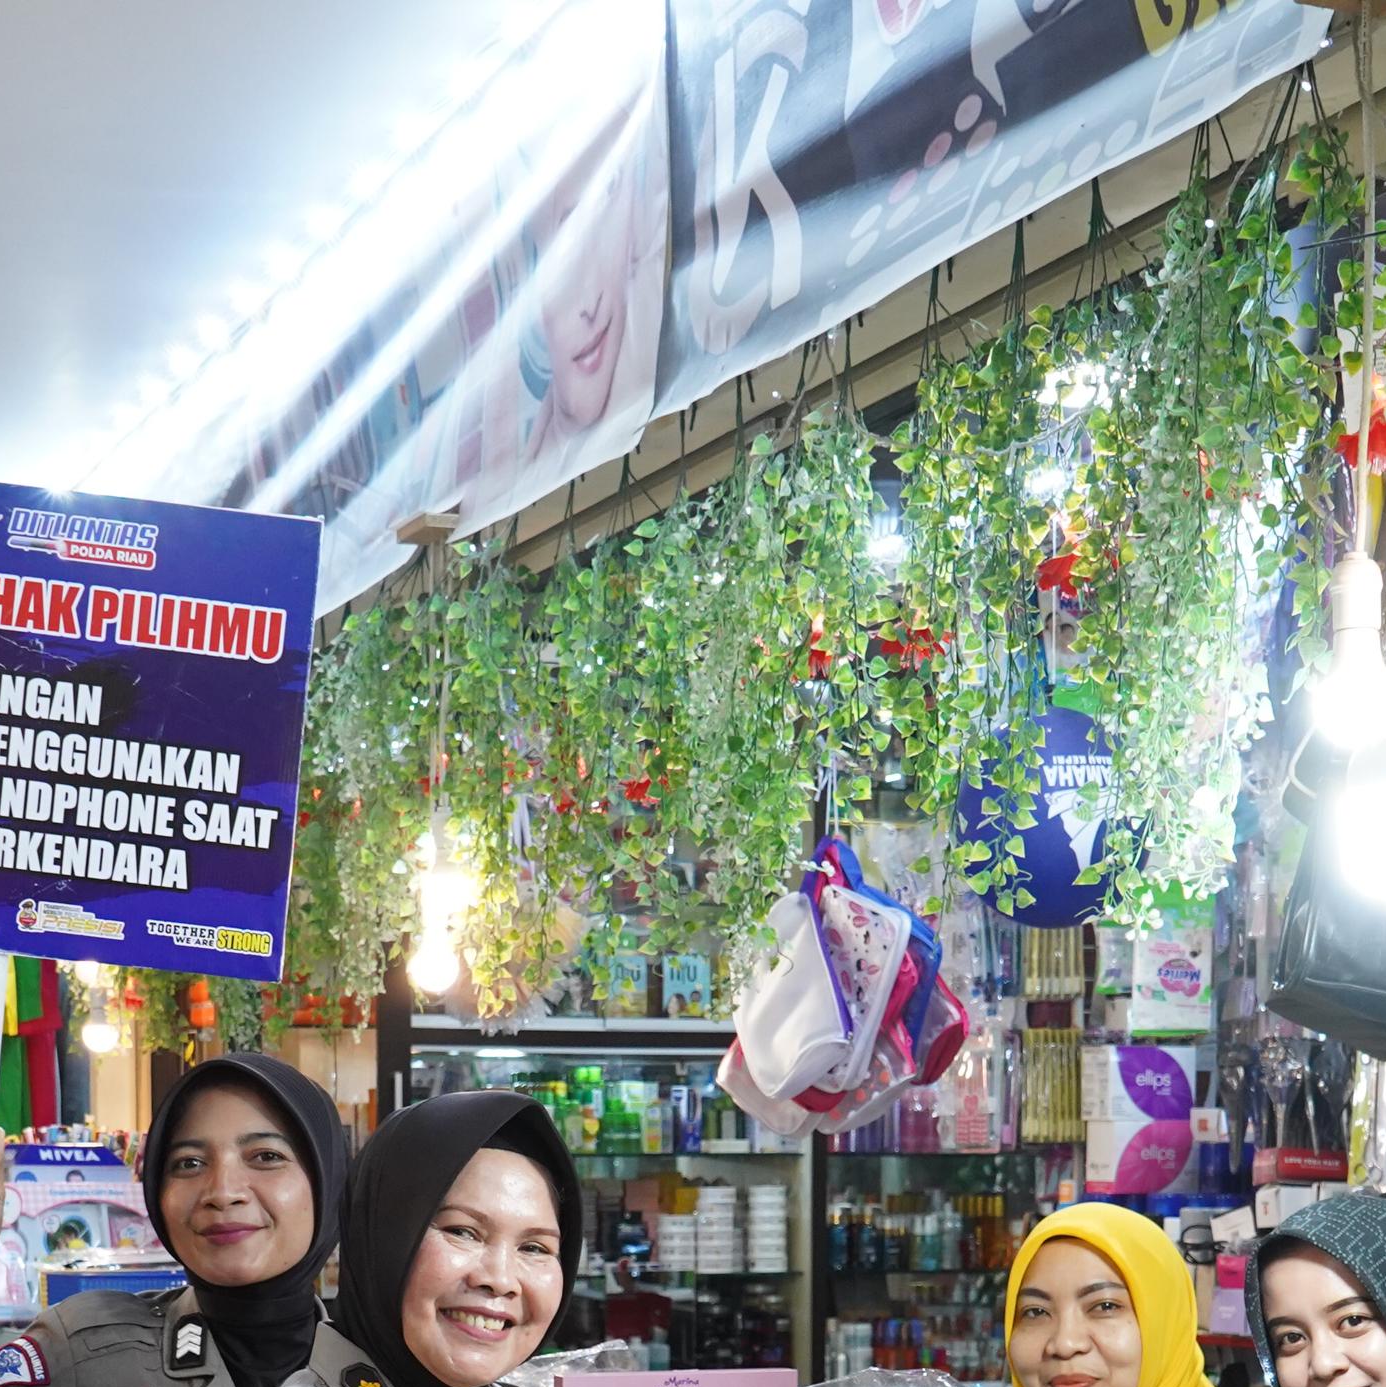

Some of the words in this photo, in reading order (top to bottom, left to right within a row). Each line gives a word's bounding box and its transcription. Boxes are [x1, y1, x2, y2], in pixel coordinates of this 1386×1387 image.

[9, 508, 158, 550] DITLANTAS
[70, 545, 115, 561] POLDA
[116, 549, 148, 565] RIAU
[88, 589, 285, 662] PILIHMU
[1052, 754, 1087, 765] KEPRI
[1043, 765, 1115, 788] AMAHA
[181, 799, 279, 851] SAAT
[149, 921, 216, 939] TOGETHER
[175, 935, 192, 946] WE
[193, 938, 215, 948] ARE
[216, 928, 272, 955] STRONG
[1135, 1068, 1172, 1090] ellips
[38, 1148, 101, 1162] NIVEA
[1140, 1144, 1176, 1166] ellips
[663, 1376, 700, 1387] Marina
